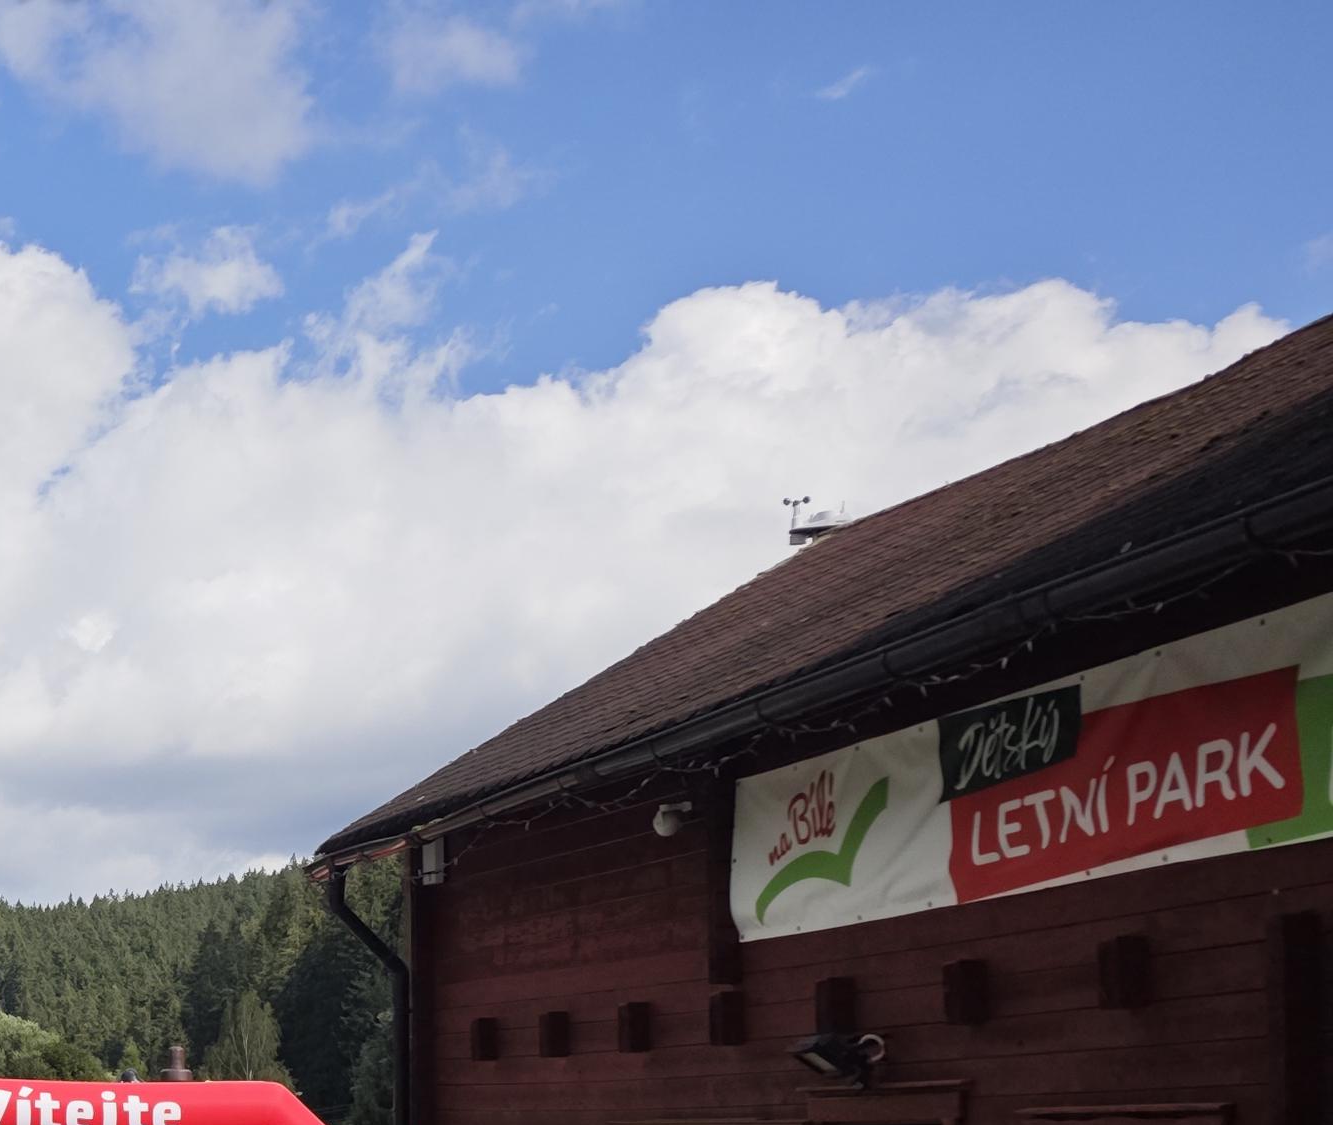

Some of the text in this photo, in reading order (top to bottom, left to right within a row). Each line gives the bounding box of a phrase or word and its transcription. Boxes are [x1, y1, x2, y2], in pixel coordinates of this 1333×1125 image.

[787, 770, 836, 845] Bílé
[971, 722, 1287, 868] LETNÍ PARK
